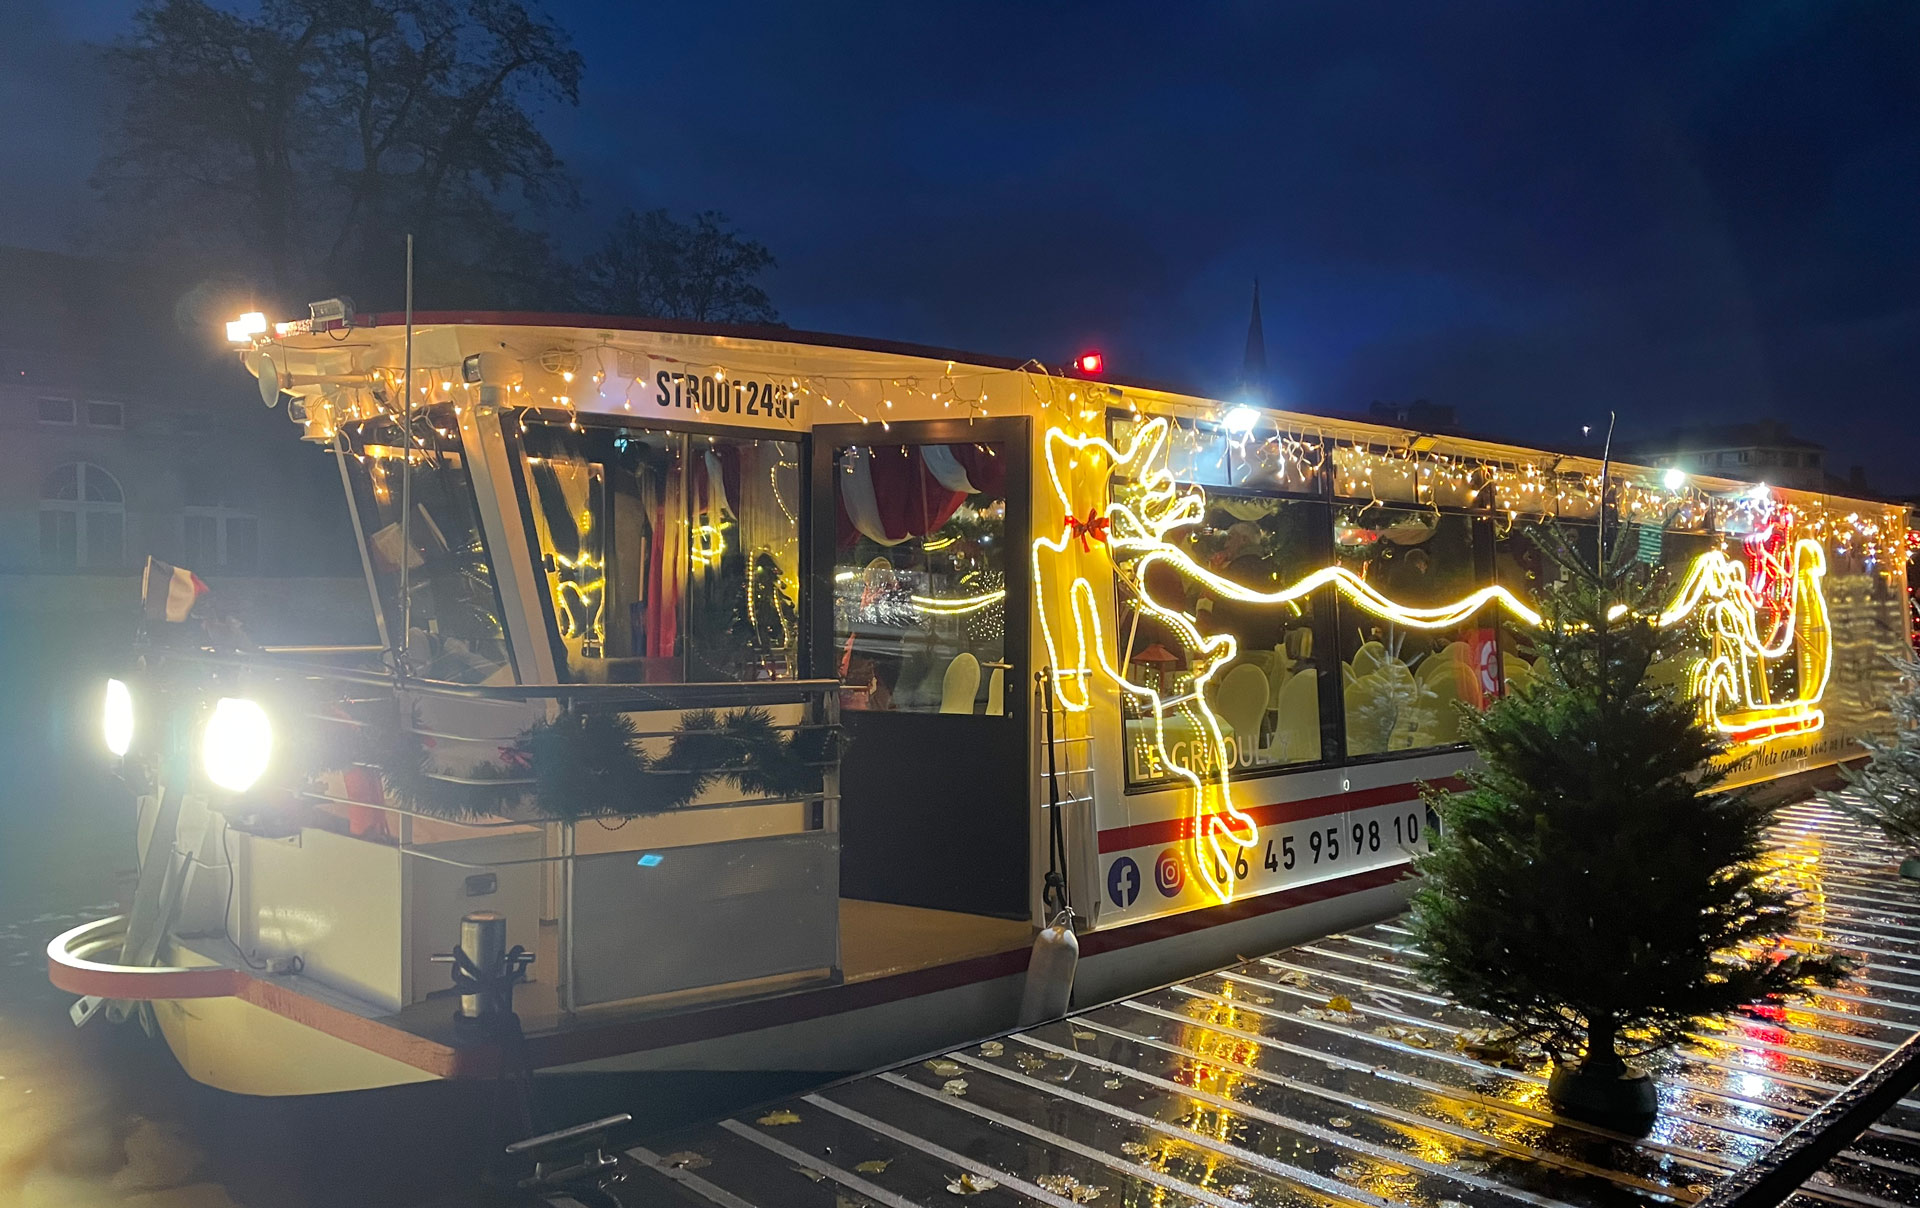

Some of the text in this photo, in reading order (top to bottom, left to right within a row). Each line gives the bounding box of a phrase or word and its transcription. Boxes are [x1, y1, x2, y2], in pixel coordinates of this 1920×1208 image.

[1134, 744, 1164, 779] LE
[1755, 745, 1777, 770] Metz
[1214, 813, 1419, 884] 06 45 95 98 10
